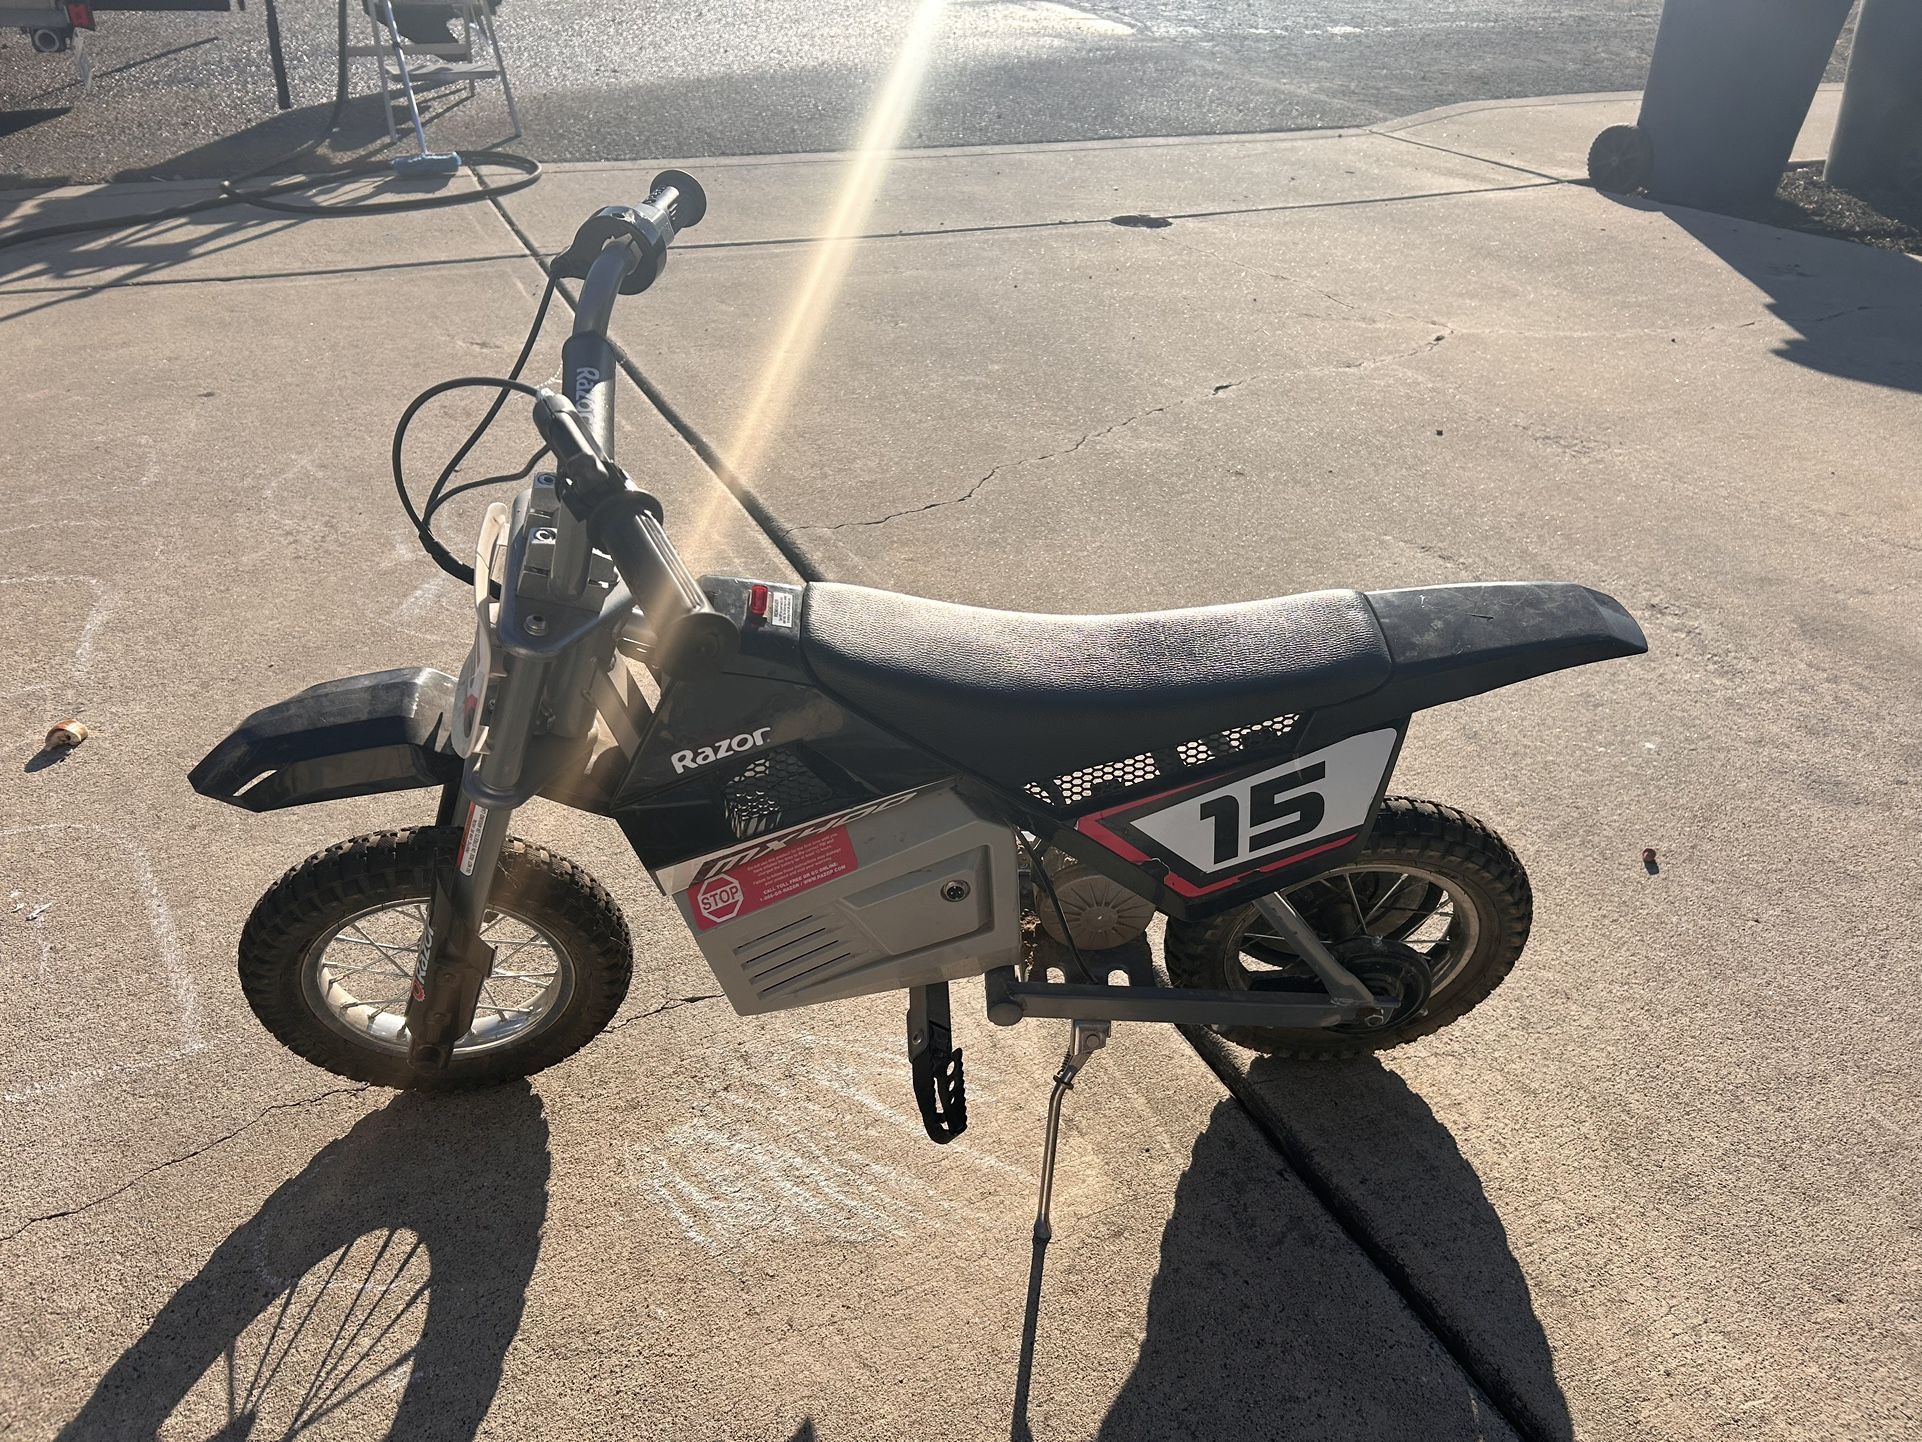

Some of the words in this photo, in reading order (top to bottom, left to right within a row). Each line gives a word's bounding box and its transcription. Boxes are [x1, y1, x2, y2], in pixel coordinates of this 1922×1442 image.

[575, 367, 600, 429] Razor
[671, 726, 772, 775] Razor
[1200, 760, 1326, 865] 15
[701, 885, 739, 911] STOP
[764, 886, 776, 894] CALL
[777, 881, 789, 889] TOLL
[415, 918, 434, 984] Razor
